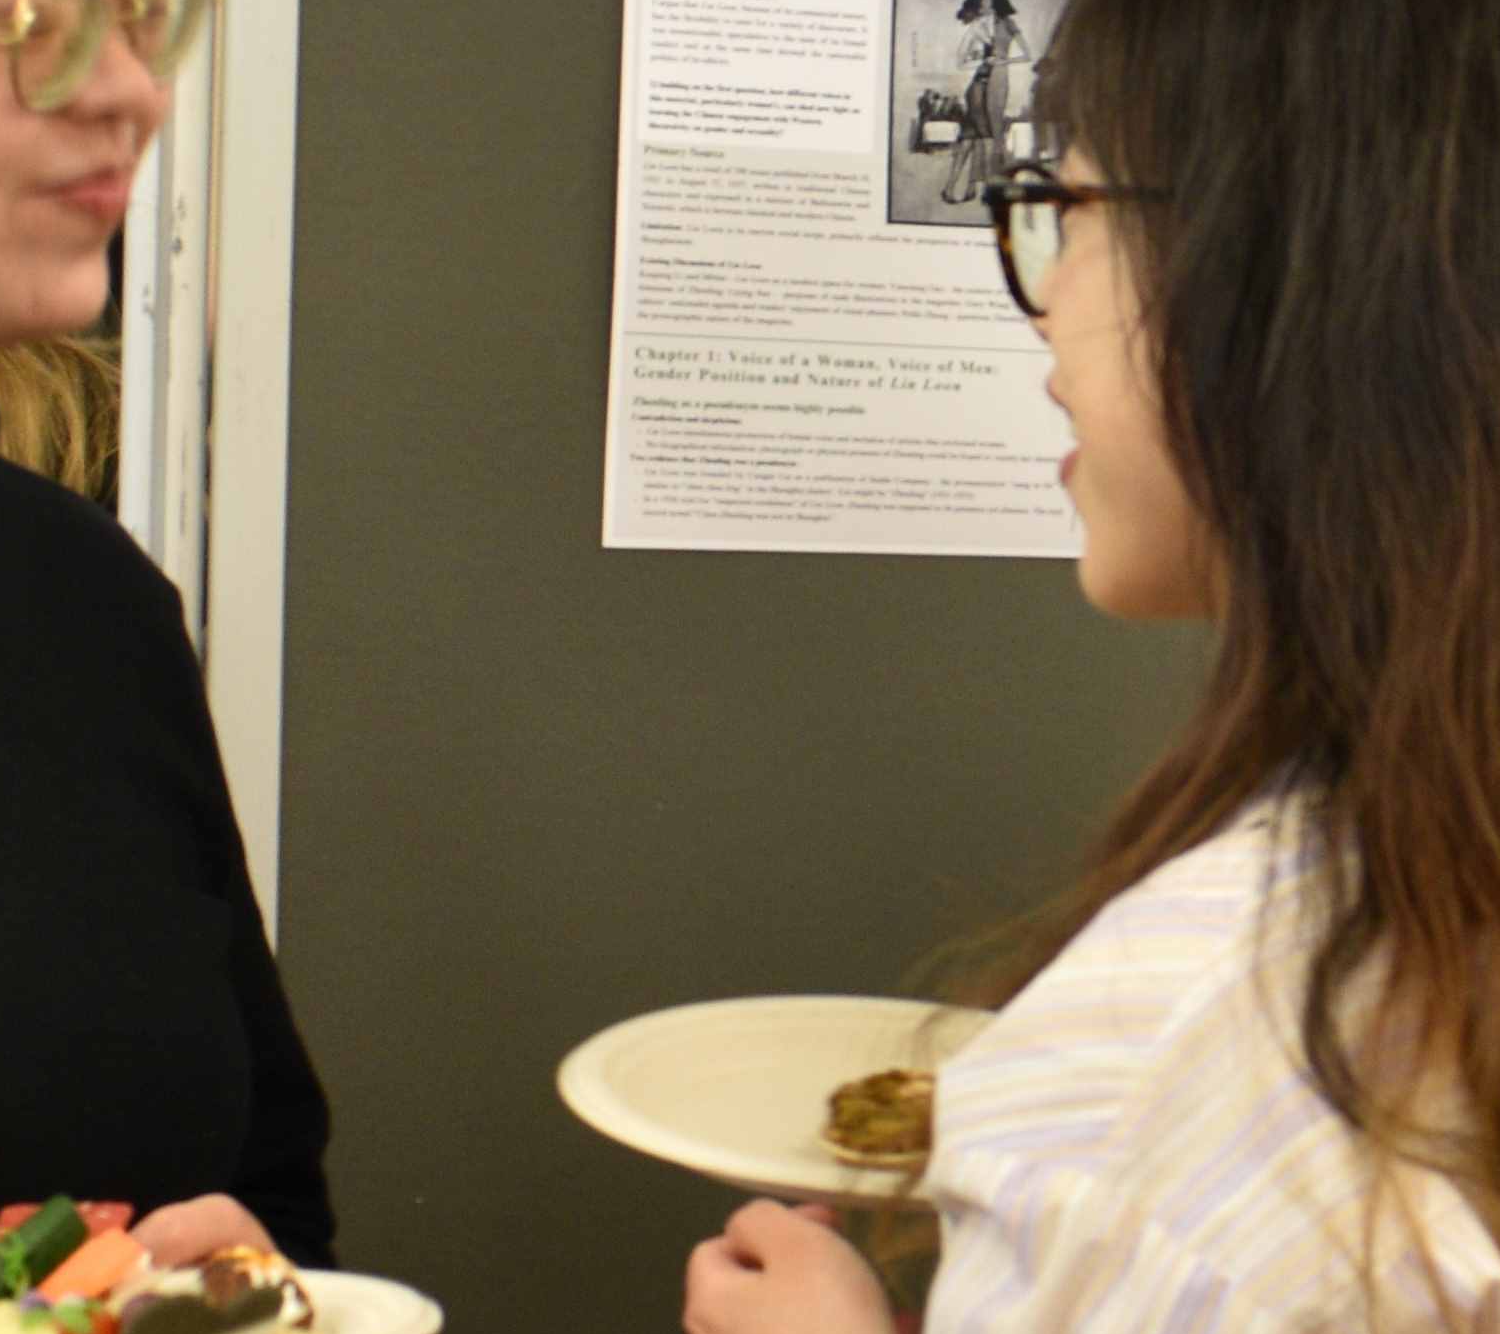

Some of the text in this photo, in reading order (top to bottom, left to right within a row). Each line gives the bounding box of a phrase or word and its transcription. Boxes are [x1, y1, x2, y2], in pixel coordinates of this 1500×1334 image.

[634, 347, 699, 362] Chapter
[728, 351, 772, 364] Voice
[778, 353, 795, 365] of
[801, 357, 809, 366] a
[888, 358, 930, 371] Voice
[937, 360, 953, 372] of
[634, 366, 960, 390] Gender Position and Nature of Lin Loon
